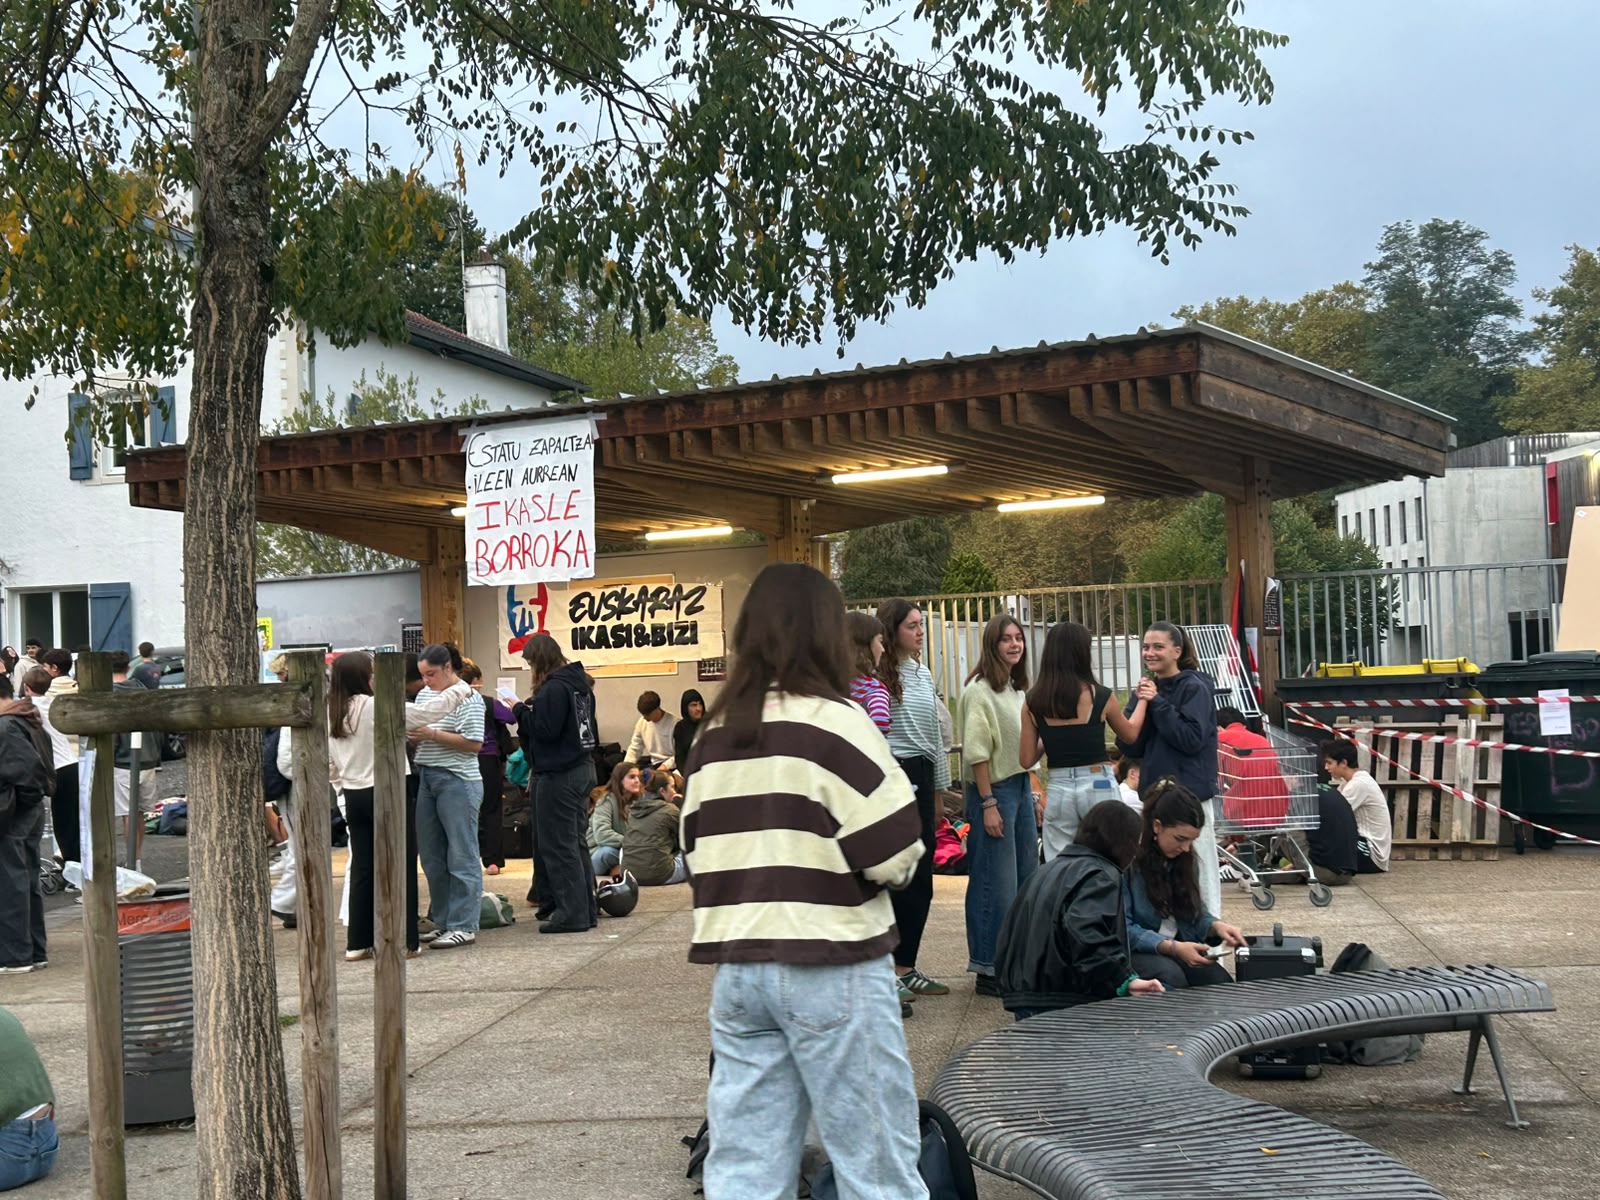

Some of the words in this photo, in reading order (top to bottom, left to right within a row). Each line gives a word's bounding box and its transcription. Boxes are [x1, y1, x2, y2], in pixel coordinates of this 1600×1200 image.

[468, 433, 521, 467] ESTATU
[529, 434, 592, 456] ZAPALTZA
[521, 464, 578, 486] AURREAN
[475, 490, 581, 530] IKASLE
[476, 530, 589, 577] BORROKA
[569, 584, 707, 623] EUSKARAZ
